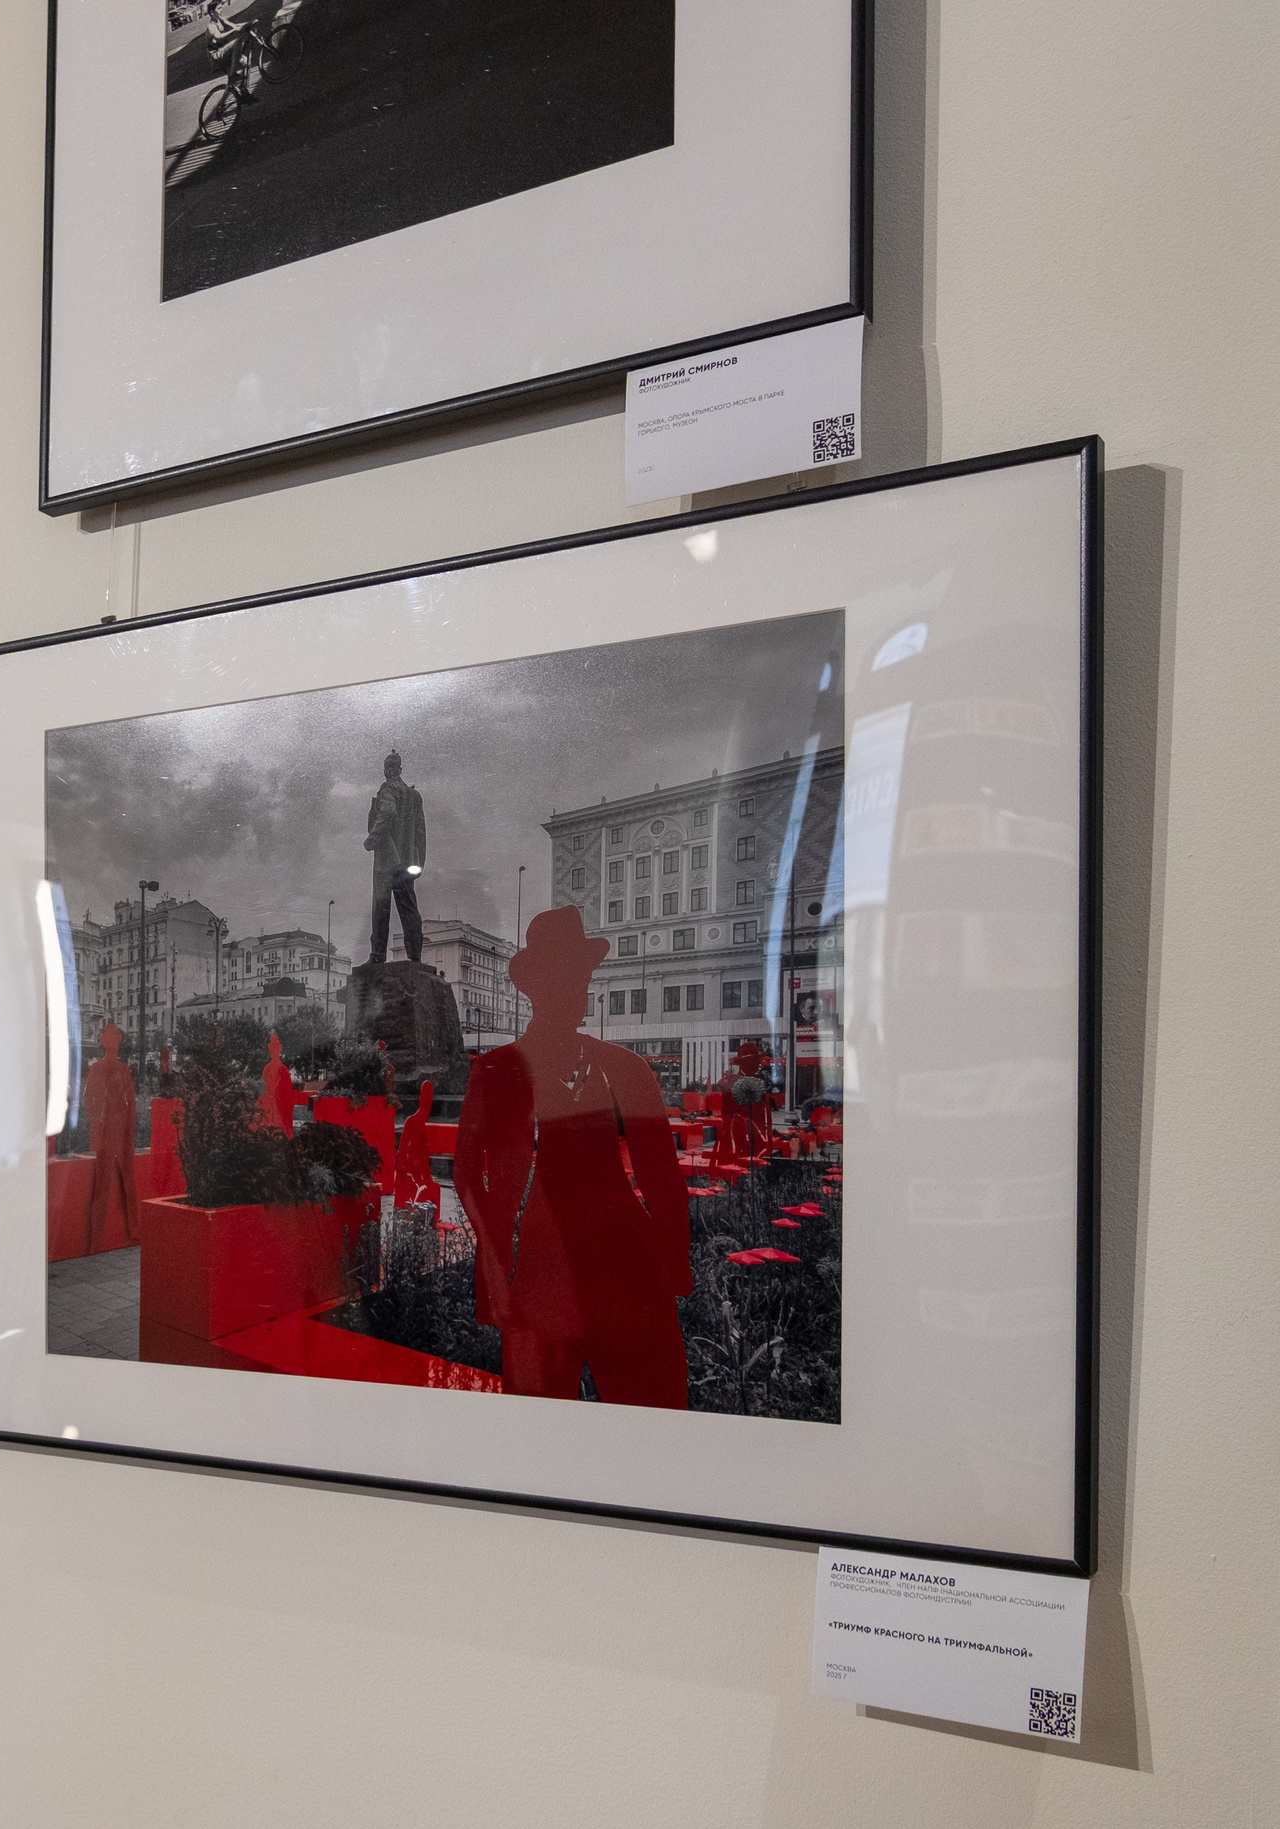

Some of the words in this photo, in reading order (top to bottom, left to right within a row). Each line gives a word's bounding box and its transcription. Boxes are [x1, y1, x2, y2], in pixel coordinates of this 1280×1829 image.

[639, 367, 685, 388] ДМИТРИЙ
[688, 356, 738, 375] СМИРНОВ
[639, 377, 691, 394] ФОТОХУДОЖНИК
[668, 411, 690, 423] ОПОРА
[692, 402, 732, 416] КРЫМСКОГО
[733, 396, 757, 408] МОСТА
[764, 389, 785, 401] ПАРКЕ
[831, 1563, 897, 1580] АЛЕКСАНДР
[899, 1571, 956, 1587] МАЛАХОВ
[830, 1581, 902, 1598] ПРОФЕССИОНАЛОВ
[903, 1591, 972, 1607] ФОТОИНДУСТРИИ)
[896, 1582, 916, 1591] ЧЛЕН
[917, 1584, 939, 1594] НАПФ
[940, 1587, 1007, 1603] (НАЦИОНАЛЬНОЙ
[1009, 1597, 1065, 1611] АССОЦИАЦИИ
[828, 1620, 872, 1634] «ТРИУМФ
[874, 1628, 925, 1642] КРАСНОГО
[927, 1635, 941, 1645] НА
[944, 1637, 1033, 1659] ТРИУМФАЛЬНОЙ»
[826, 1663, 856, 1673] МОСКВА
[826, 1670, 842, 1680] 2025
